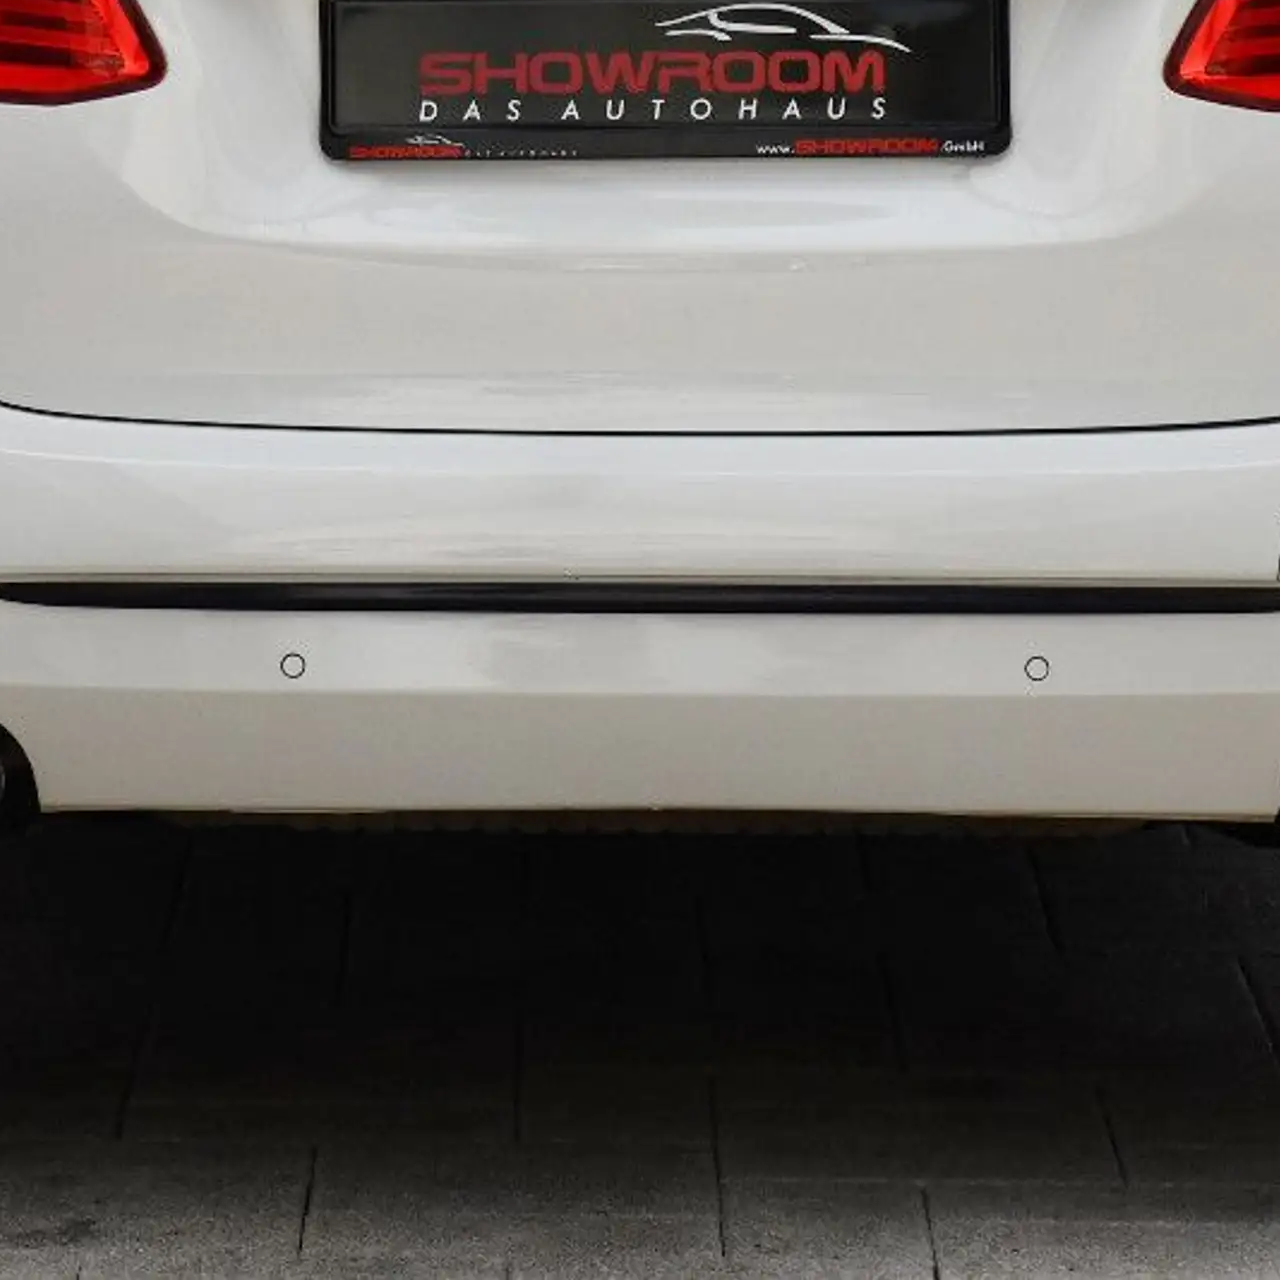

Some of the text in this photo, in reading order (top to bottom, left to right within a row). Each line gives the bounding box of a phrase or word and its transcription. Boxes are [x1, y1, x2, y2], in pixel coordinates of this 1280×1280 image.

[419, 50, 888, 97] SHOWROOM
[419, 97, 888, 122] DAS AUTOHAUS
